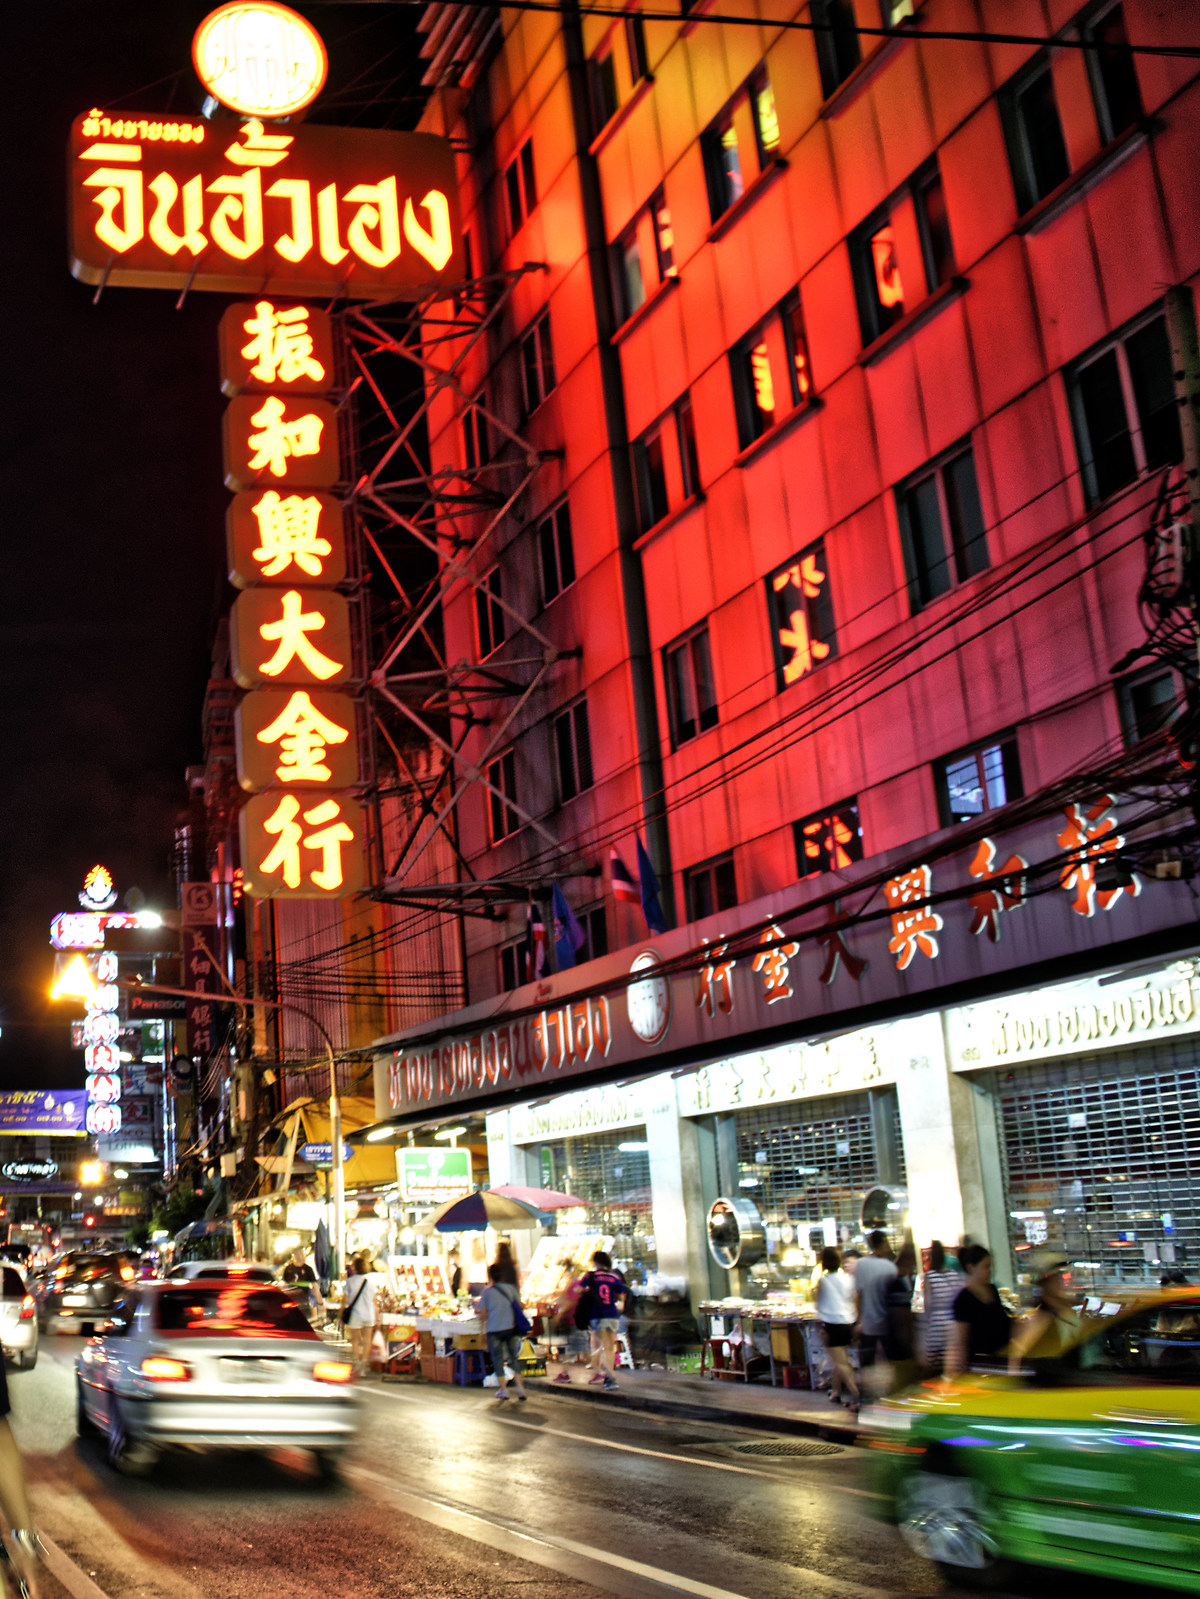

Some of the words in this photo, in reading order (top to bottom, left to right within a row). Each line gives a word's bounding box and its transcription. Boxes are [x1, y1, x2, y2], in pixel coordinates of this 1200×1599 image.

[78, 120, 453, 271] จินฮั้วเฮง
[241, 301, 355, 891] 振和興大金行
